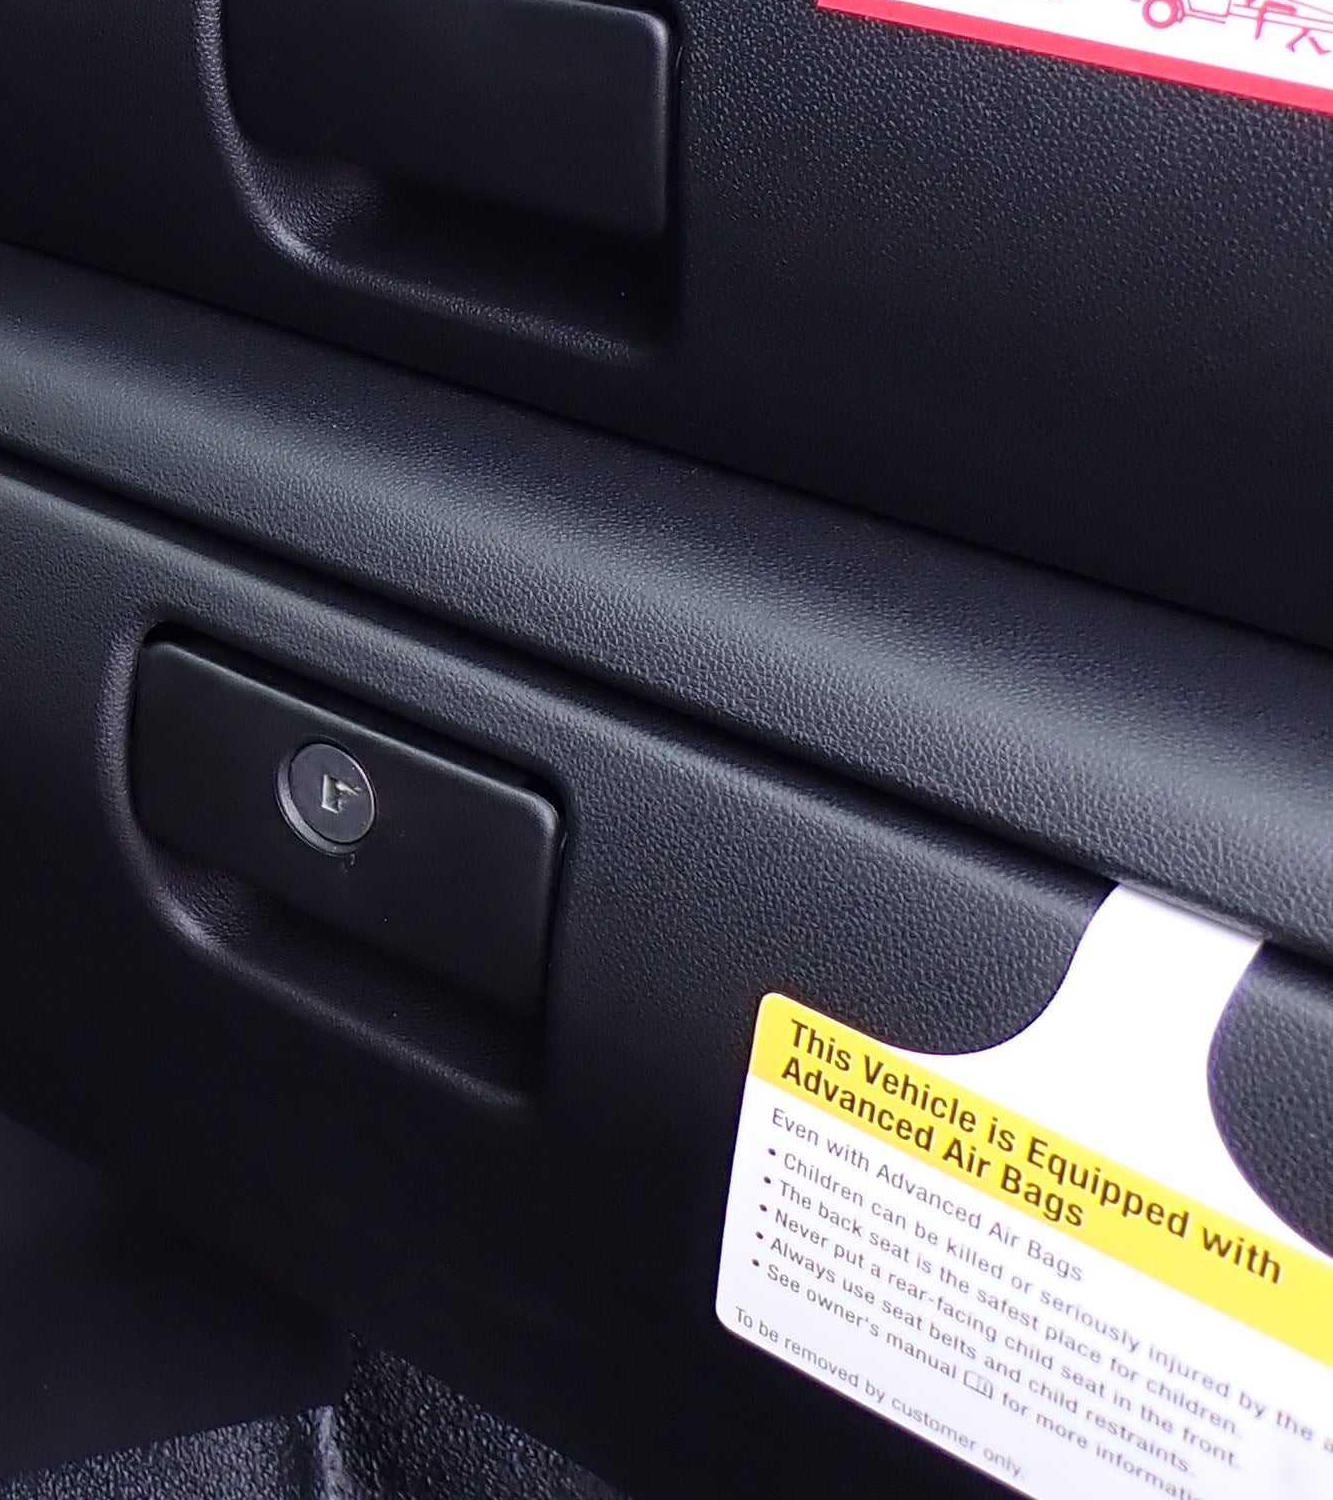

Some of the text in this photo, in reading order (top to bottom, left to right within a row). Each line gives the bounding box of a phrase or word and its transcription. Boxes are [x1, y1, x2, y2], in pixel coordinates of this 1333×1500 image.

[773, 1108, 1081, 1280] Even with Advanced Air Bags
[781, 1057, 1083, 1226] Advanced Air Bags
[792, 1020, 1280, 1284] This Vehicle is Equipped with
[735, 1306, 753, 1328] To
[759, 1320, 779, 1343] be
[785, 1338, 859, 1388] removed
[865, 1380, 885, 1403] by
[892, 1398, 975, 1450] customer
[770, 1238, 835, 1283] Always
[843, 1279, 875, 1304] use
[882, 1300, 922, 1331] seat
[929, 1322, 976, 1359] belts
[985, 1356, 1021, 1383] and
[1029, 1380, 1077, 1413] child
[775, 1208, 828, 1248] Never
[834, 1244, 864, 1268] put
[871, 1264, 880, 1278] a
[889, 1274, 997, 1342] rear-facing
[1005, 1337, 1053, 1370] child
[1061, 1366, 1104, 1398] seat
[1114, 1394, 1131, 1410] in
[1141, 1406, 1172, 1432] the
[780, 1180, 811, 1210] The
[819, 1201, 863, 1237] back
[869, 1232, 909, 1263] seat
[917, 1257, 931, 1274] is
[940, 1267, 969, 1293] the
[977, 1290, 1037, 1331] safest
[1045, 1326, 1101, 1363] place
[1111, 1358, 1137, 1381] for
[784, 1153, 1312, 1436] Children can be killed or seriously injured by the
[767, 1264, 1199, 1500] See owner's manual for more informati
